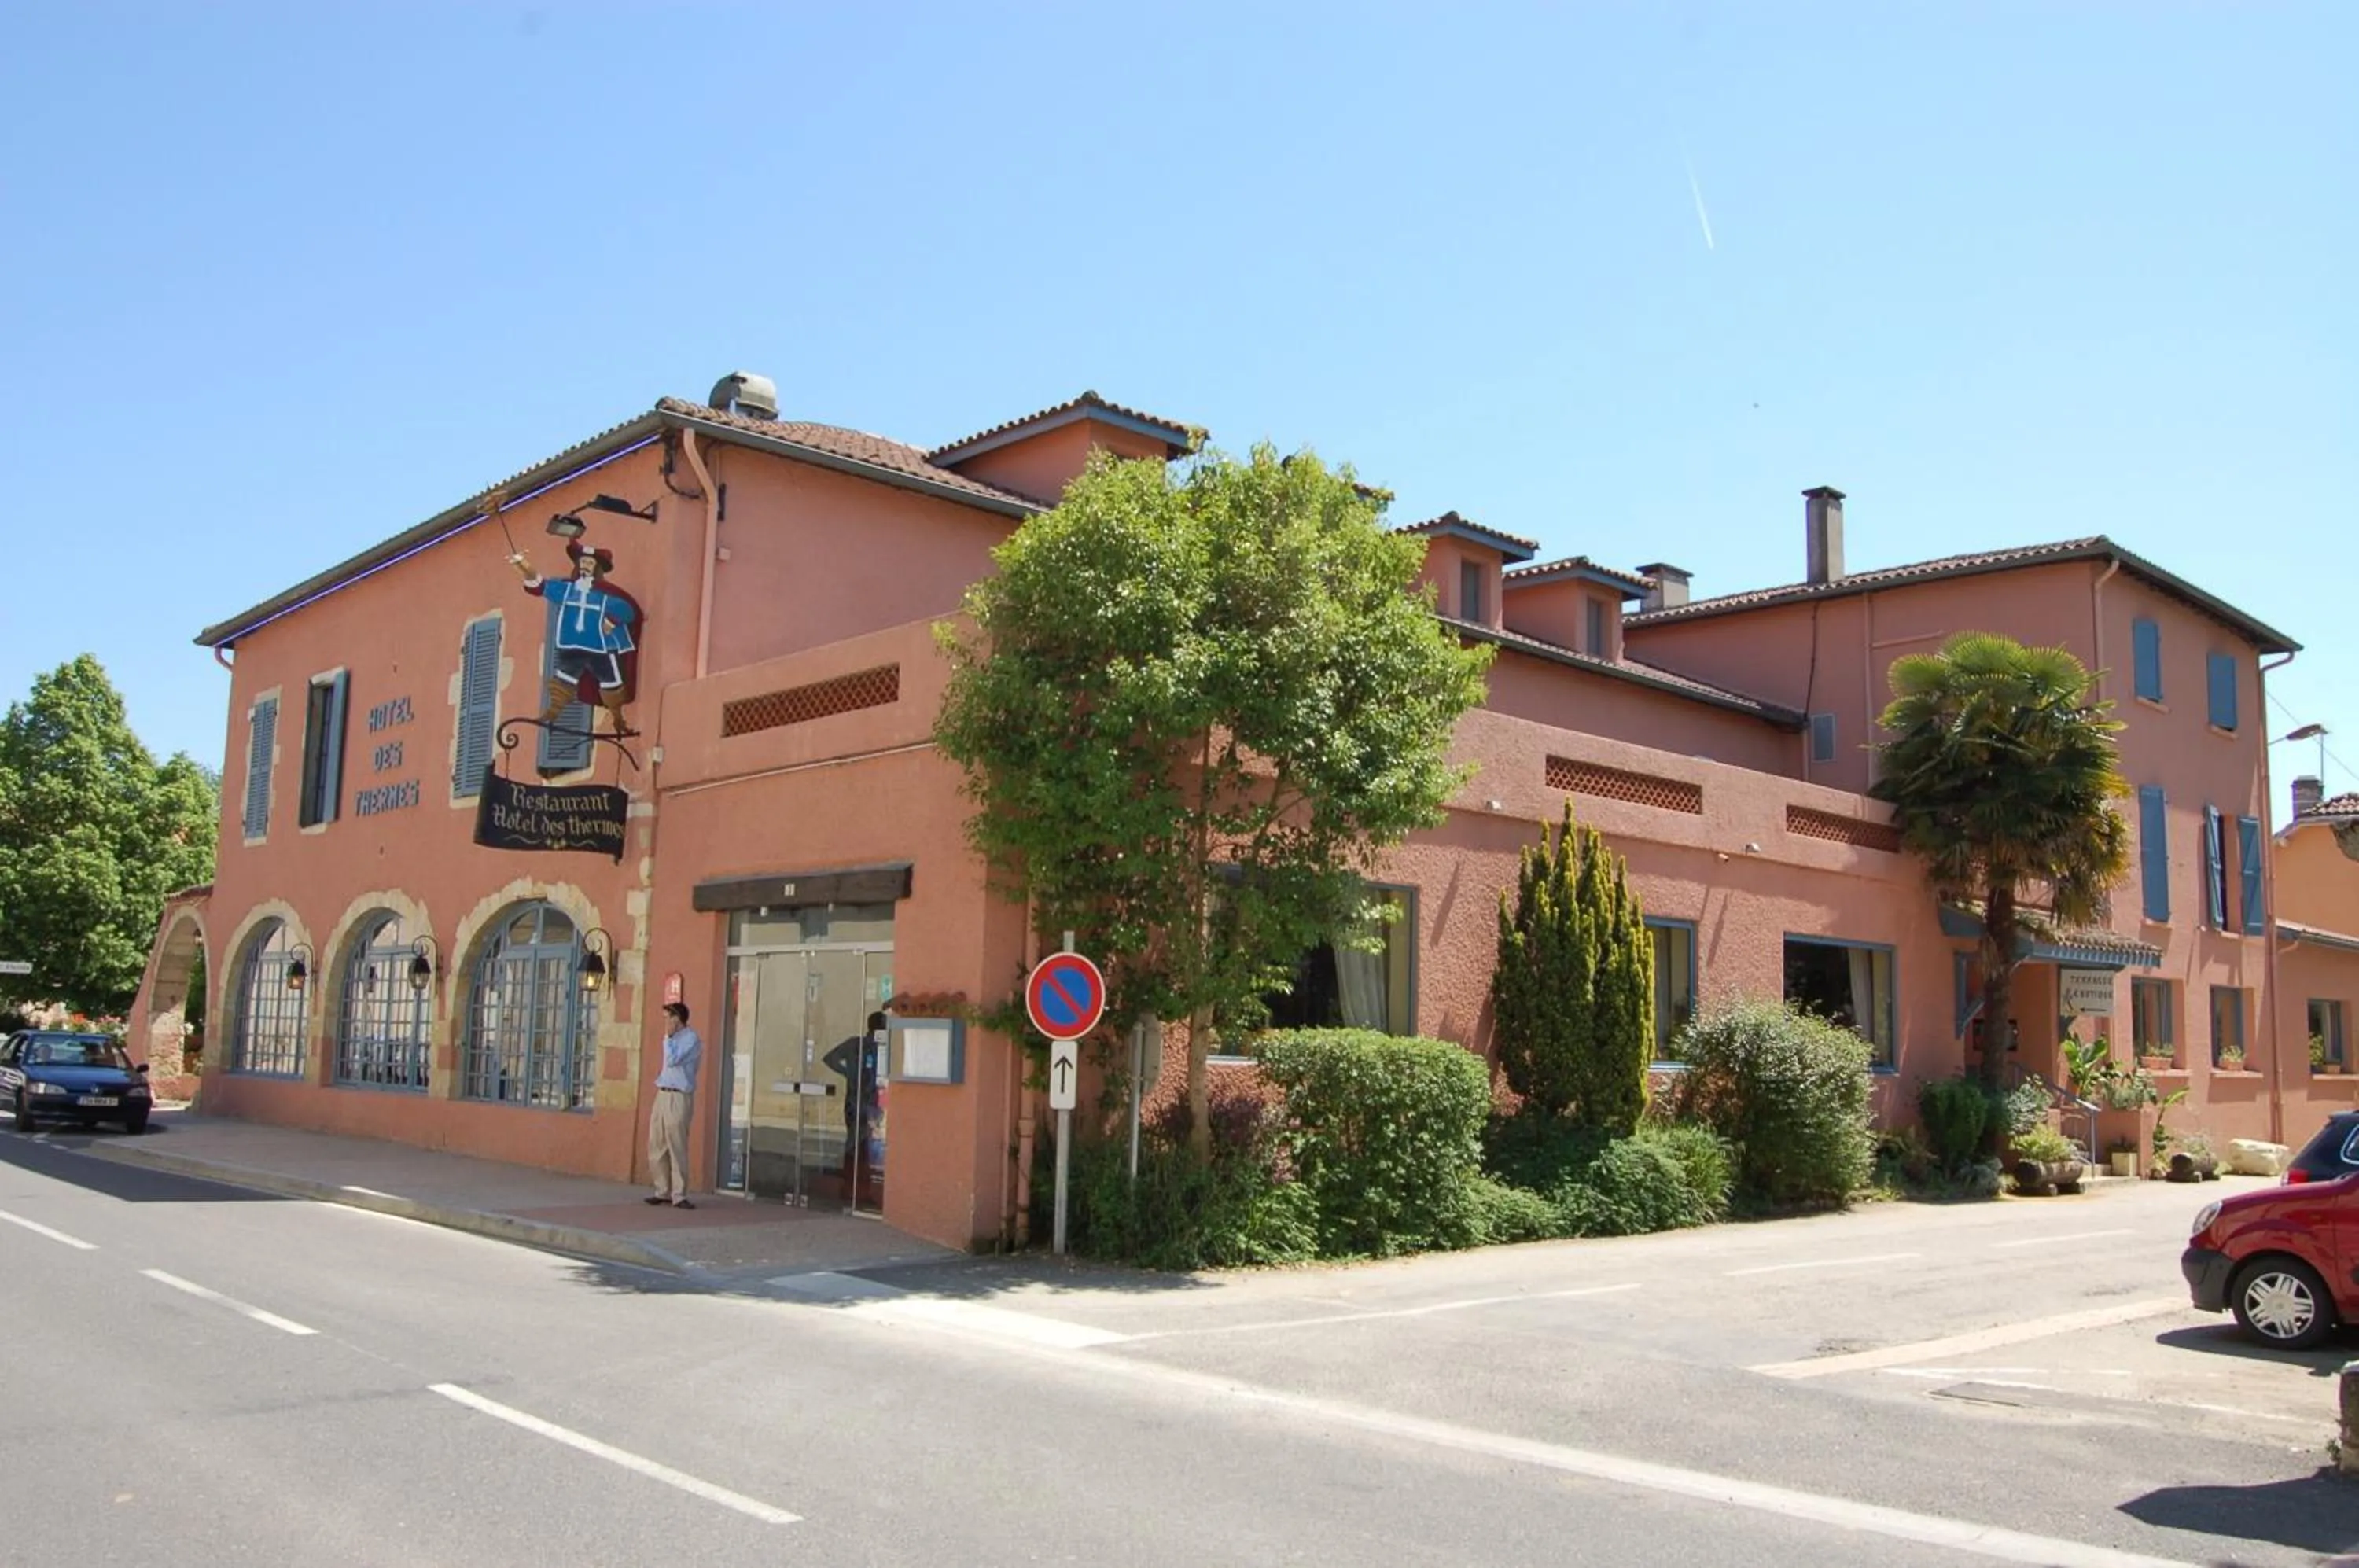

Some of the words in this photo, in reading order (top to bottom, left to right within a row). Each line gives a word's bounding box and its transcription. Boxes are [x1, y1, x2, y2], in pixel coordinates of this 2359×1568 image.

[368, 695, 415, 734] HOTEL
[374, 742, 403, 772] DES
[355, 778, 421, 818] THERMES
[511, 785, 610, 812] Restaurant
[541, 815, 565, 836] des
